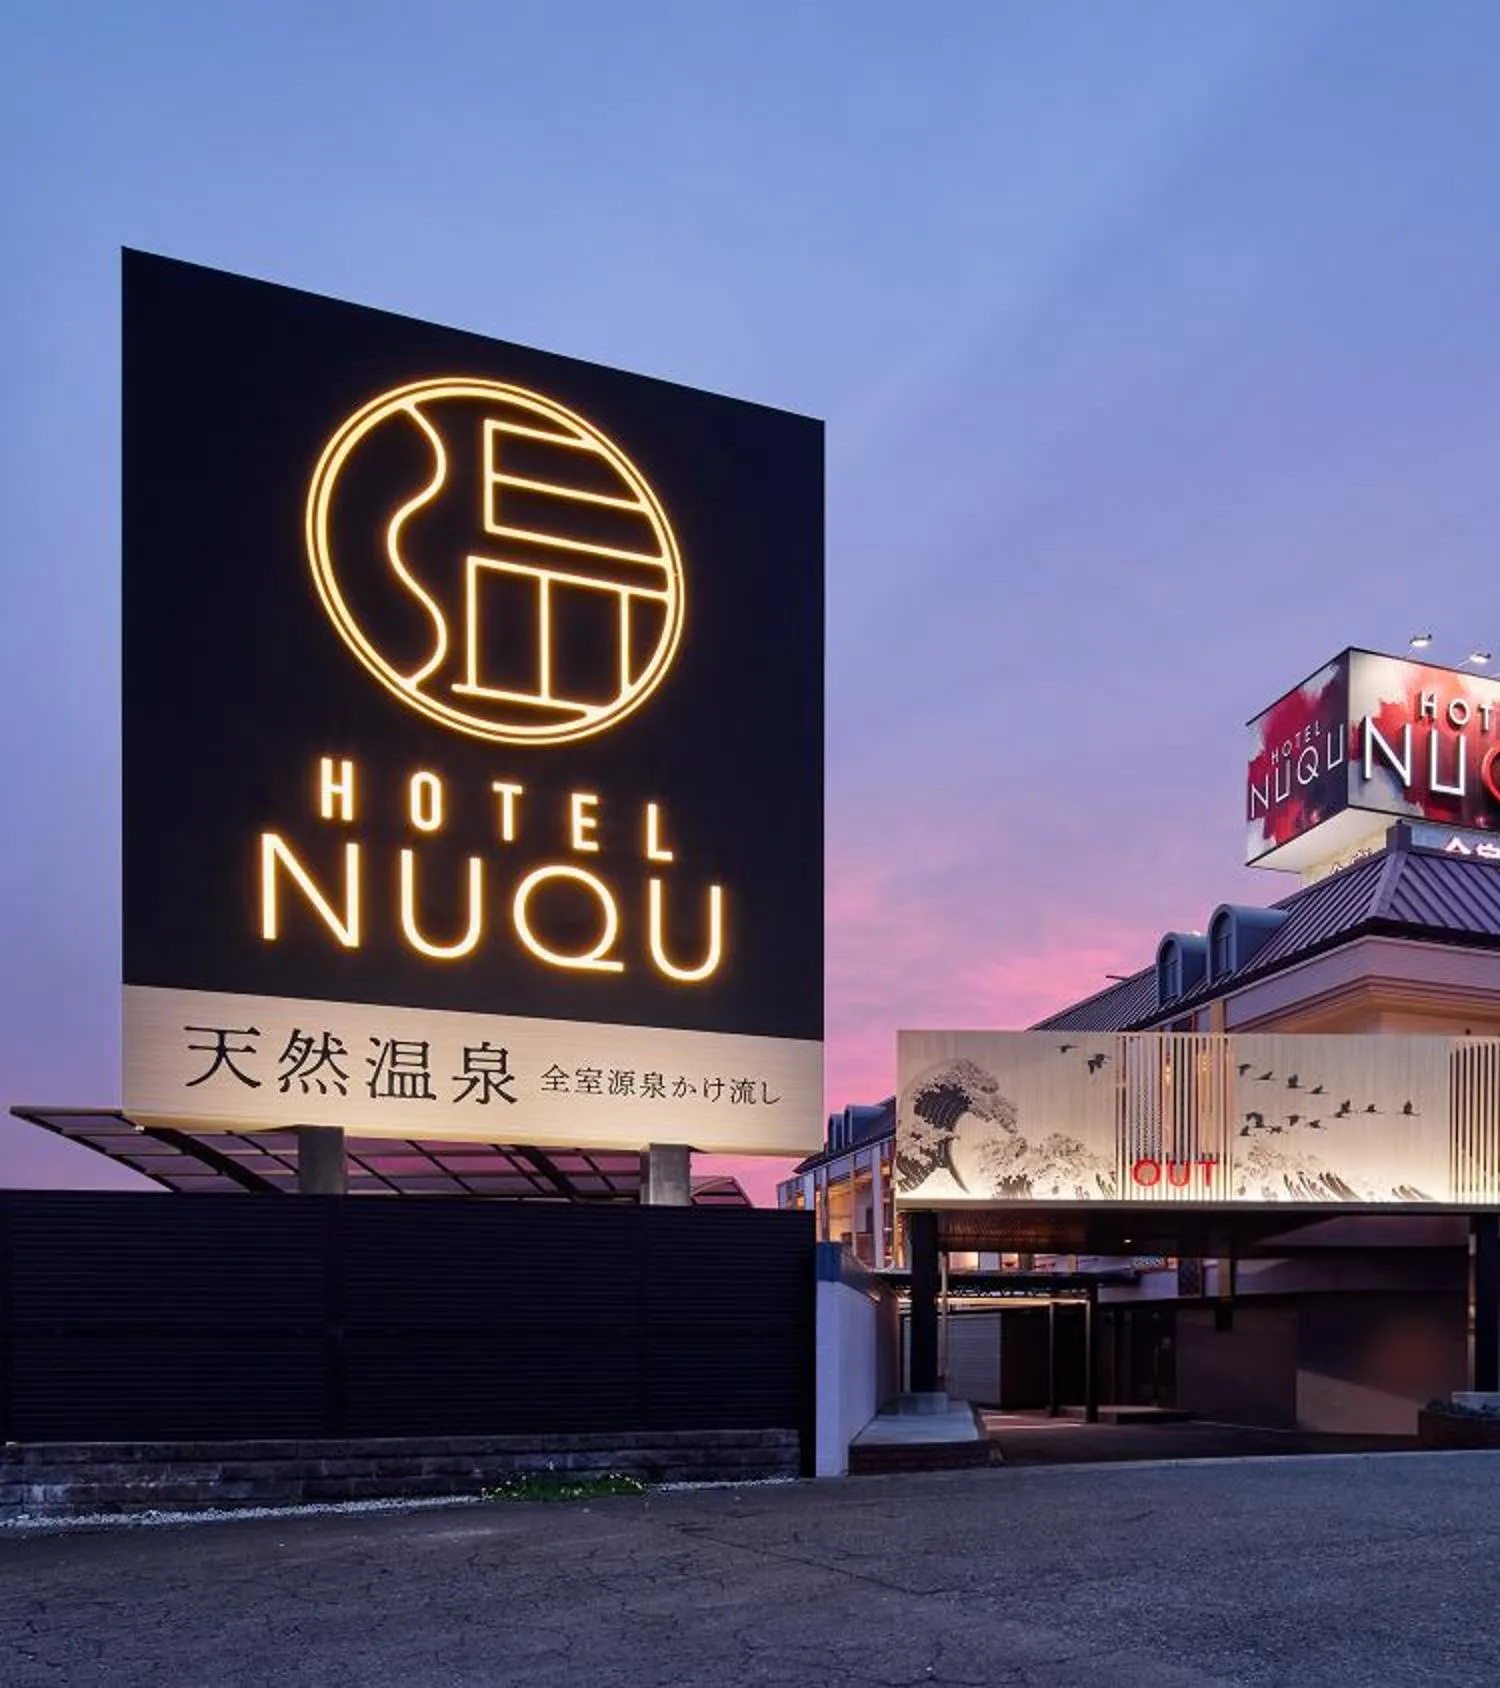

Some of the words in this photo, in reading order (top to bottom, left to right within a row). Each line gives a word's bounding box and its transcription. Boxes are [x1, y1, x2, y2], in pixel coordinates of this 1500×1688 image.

[1250, 723, 1345, 819] NUQU
[1271, 720, 1321, 766] HOTEL
[320, 757, 674, 863] HOTEL
[261, 831, 724, 983] NUQU
[184, 1025, 519, 1107] 天然温泉
[540, 1063, 782, 1105] 全室源泉かけ流し
[1131, 1157, 1218, 1188] OUT
